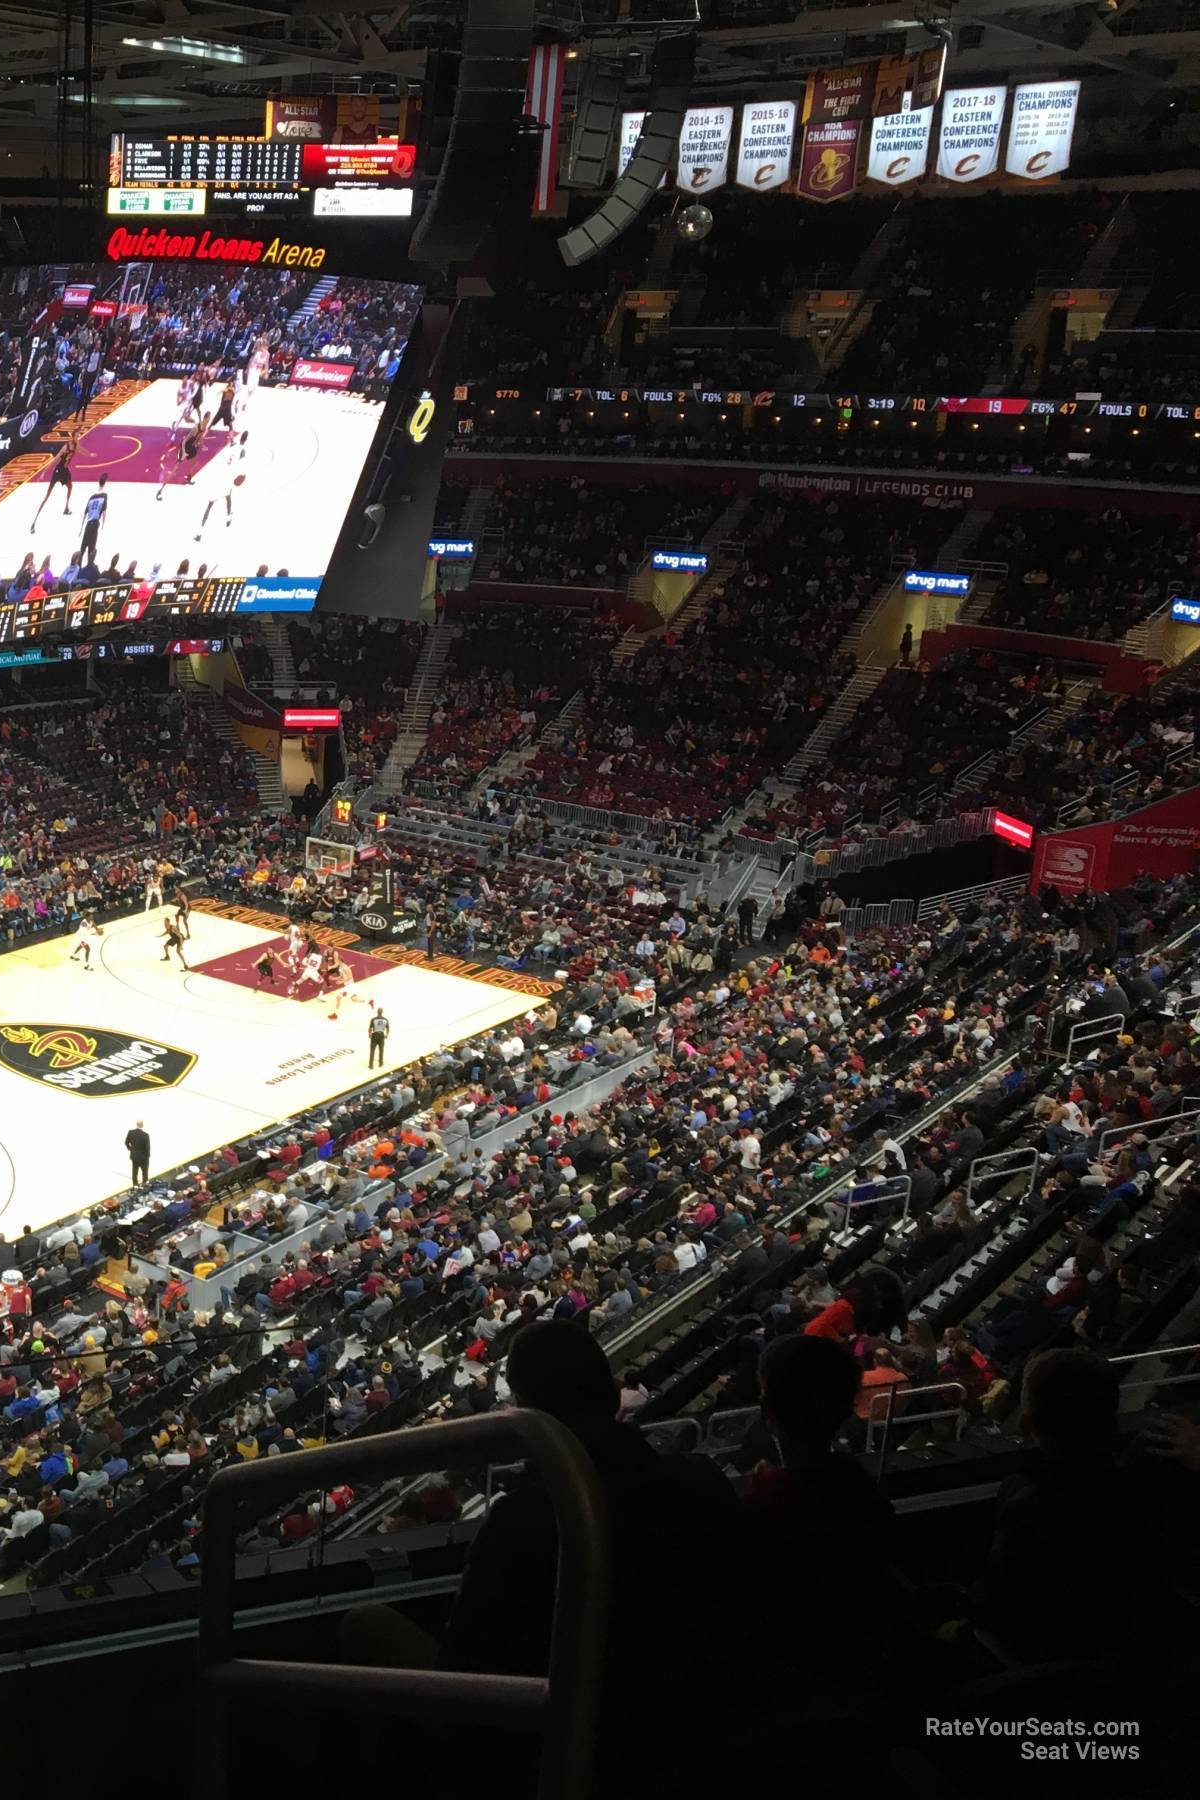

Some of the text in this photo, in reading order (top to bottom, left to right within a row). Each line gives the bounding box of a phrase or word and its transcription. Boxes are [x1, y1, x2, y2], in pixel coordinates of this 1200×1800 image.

[824, 94, 861, 108] THE FIRST
[1017, 89, 1077, 100] CENTRAL DIVISION
[952, 95, 996, 108] 2017-18
[1019, 98, 1072, 111] CHAMPIONS
[688, 115, 725, 126] 2014-15
[752, 109, 789, 120] 2015-16
[884, 114, 922, 126] EASTERN
[952, 110, 992, 123] EASTERN
[689, 130, 721, 140] EASTERN
[752, 123, 786, 135] EASTERN
[808, 129, 856, 142] CHAMPIONS
[875, 127, 927, 139] CONFERENCE
[943, 123, 999, 137] CONFERENCE
[682, 140, 727, 151] CONFERENCE
[744, 136, 791, 147] CONFERENCE
[876, 140, 923, 152] CHAMPIONS
[943, 137, 995, 150] CHAMPIONS
[682, 152, 723, 163] CHAMPIONS
[744, 148, 788, 159] CHAMPIONS
[107, 226, 326, 268] Quicken Loans Arena
[295, 363, 348, 382] Budweiser
[569, 390, 1188, 418] -7 TOL: 6 FOULS 2 FG% 28 12 14 3:19 19 FG% 47 FOULS 0 TOL:
[409, 399, 435, 443] Q
[777, 473, 930, 496] Huntington LEGENDS
[447, 542, 473, 552] mart
[654, 553, 707, 567] drug mart
[906, 574, 968, 590] drug mart
[257, 589, 294, 599] Cleveland
[126, 603, 140, 618] 19
[1173, 602, 1200, 620] drug
[71, 611, 85, 627] 12
[94, 611, 114, 624] 3:19
[98, 646, 106, 657] 3
[124, 645, 154, 653] ASSISTS
[173, 643, 181, 653] 4
[1121, 824, 1143, 833] The
[1112, 834, 1166, 846] Stores of
[1045, 871, 1085, 884] Speedway
[366, 916, 383, 927] KIA
[392, 920, 417, 934] drug mart
[43, 1041, 168, 1089] CAVALIERS
[265, 1048, 355, 1086] Quicken Loans
[278, 1053, 316, 1070] Arena
